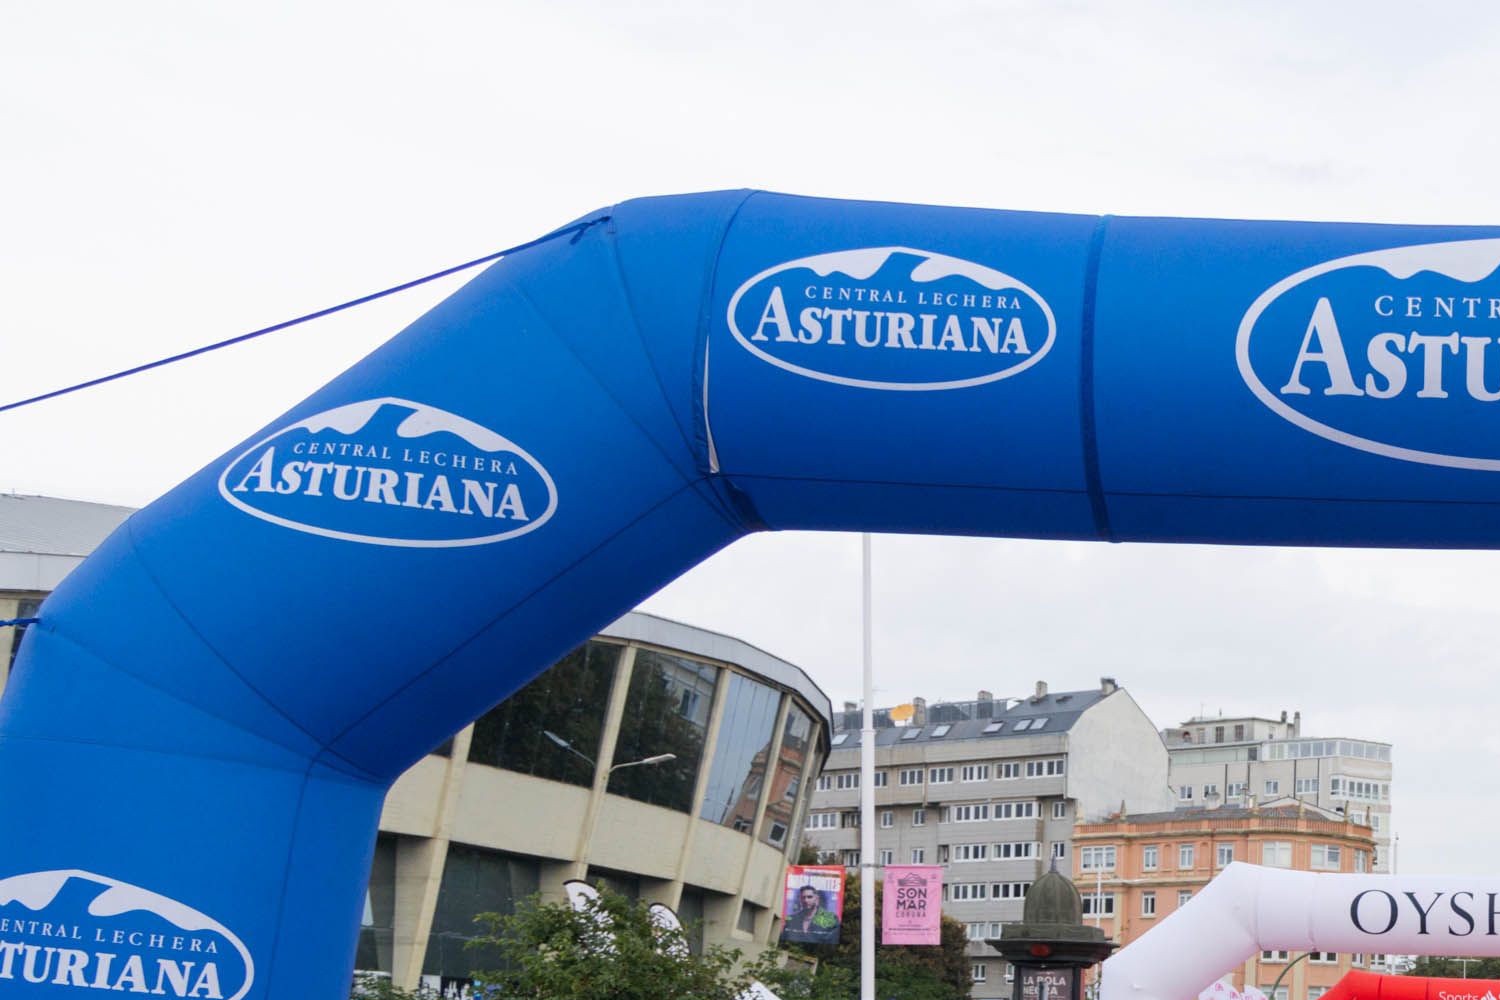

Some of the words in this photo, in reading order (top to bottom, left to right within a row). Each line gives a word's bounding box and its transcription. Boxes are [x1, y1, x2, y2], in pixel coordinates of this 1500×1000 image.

[805, 286, 908, 305] CENTRAL
[918, 291, 1022, 311] LECHERA
[752, 286, 1030, 354] ASTURIANA
[294, 442, 393, 461] CENTRAL
[403, 448, 520, 476] LECHERA
[233, 444, 528, 520] ASTURIANA
[896, 887, 927, 899] SON
[95, 928, 220, 955] LECHERA
